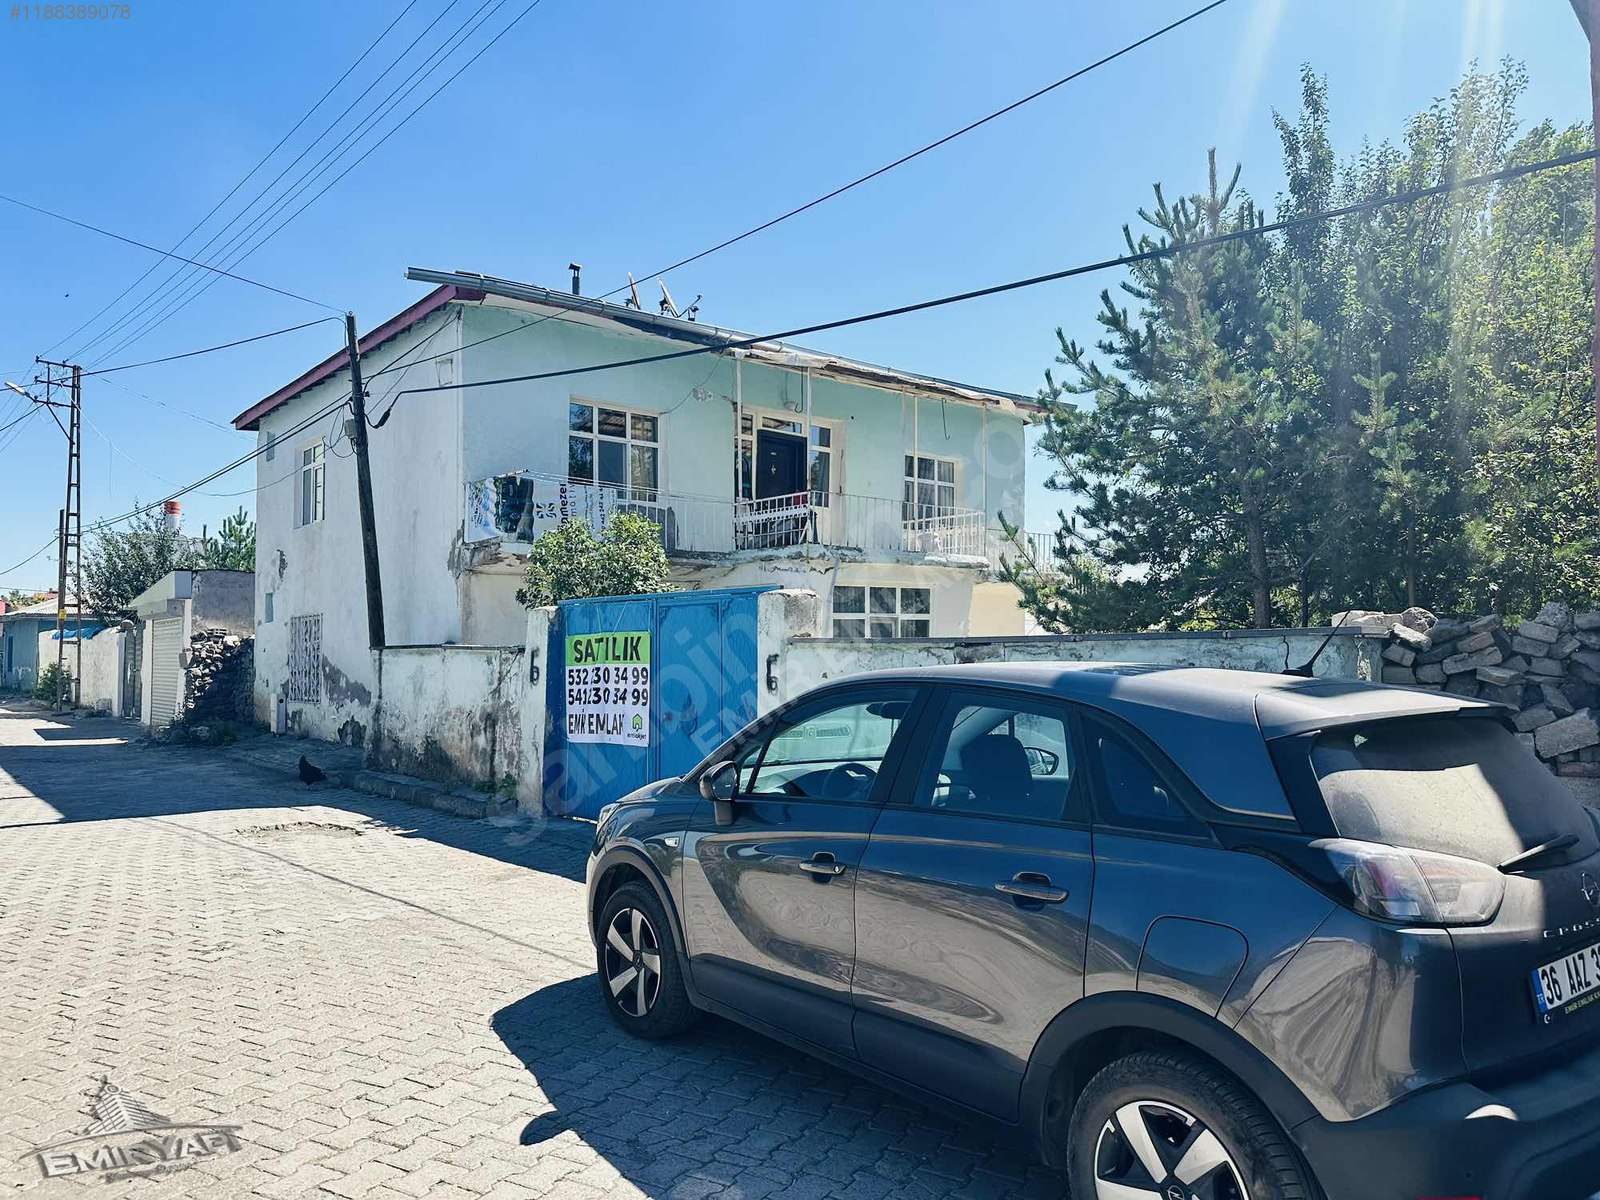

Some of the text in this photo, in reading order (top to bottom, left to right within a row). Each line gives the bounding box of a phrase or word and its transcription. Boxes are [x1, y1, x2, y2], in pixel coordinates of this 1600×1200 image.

[573, 635, 641, 663] SATILIK
[568, 668, 589, 686] 532
[614, 667, 628, 684] 34
[632, 667, 649, 686] 99
[568, 688, 587, 706] 541
[612, 687, 628, 705] 34
[631, 688, 649, 706] 99
[1541, 965, 1562, 1005] 36
[1565, 953, 1592, 995] AAZ
